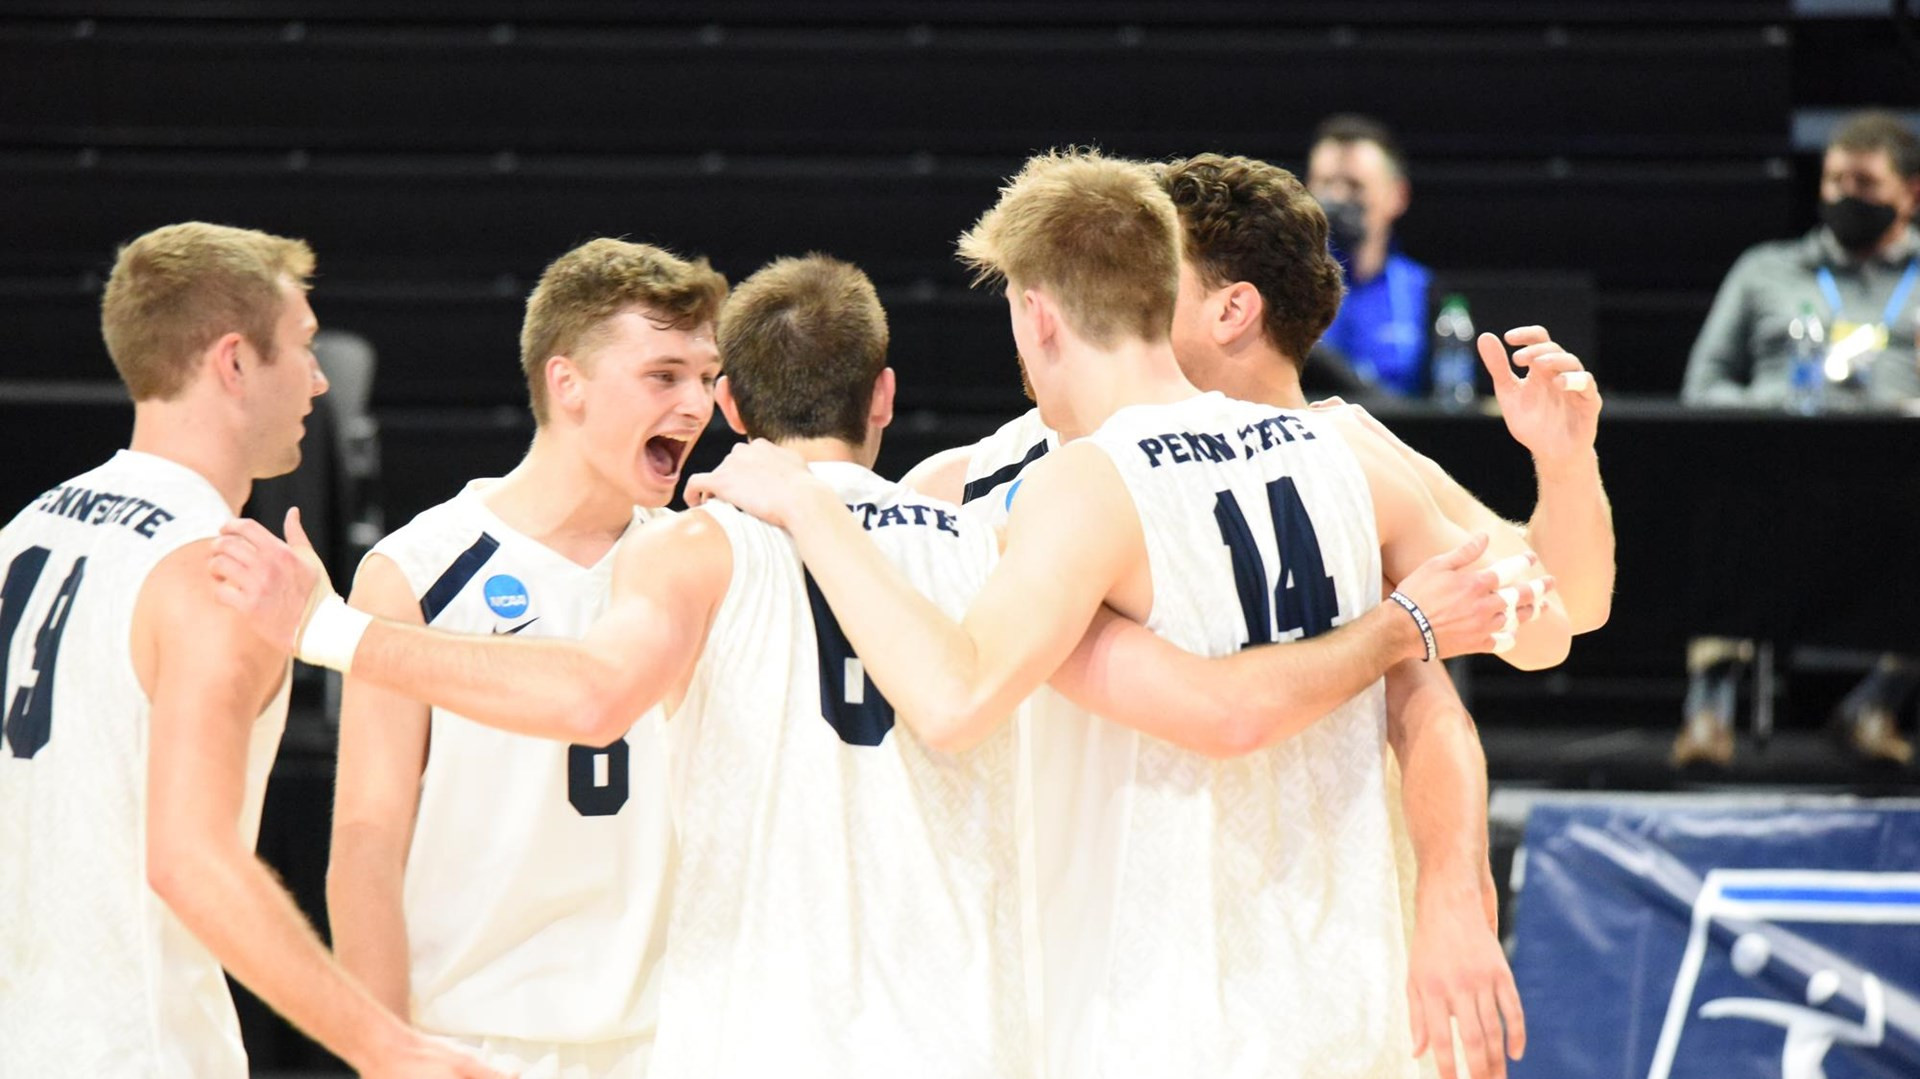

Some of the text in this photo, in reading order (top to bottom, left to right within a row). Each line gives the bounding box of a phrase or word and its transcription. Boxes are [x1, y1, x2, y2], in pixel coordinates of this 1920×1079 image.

[1137, 431, 1237, 468] PENN
[844, 502, 960, 538] TATE
[1213, 475, 1340, 650] 14
